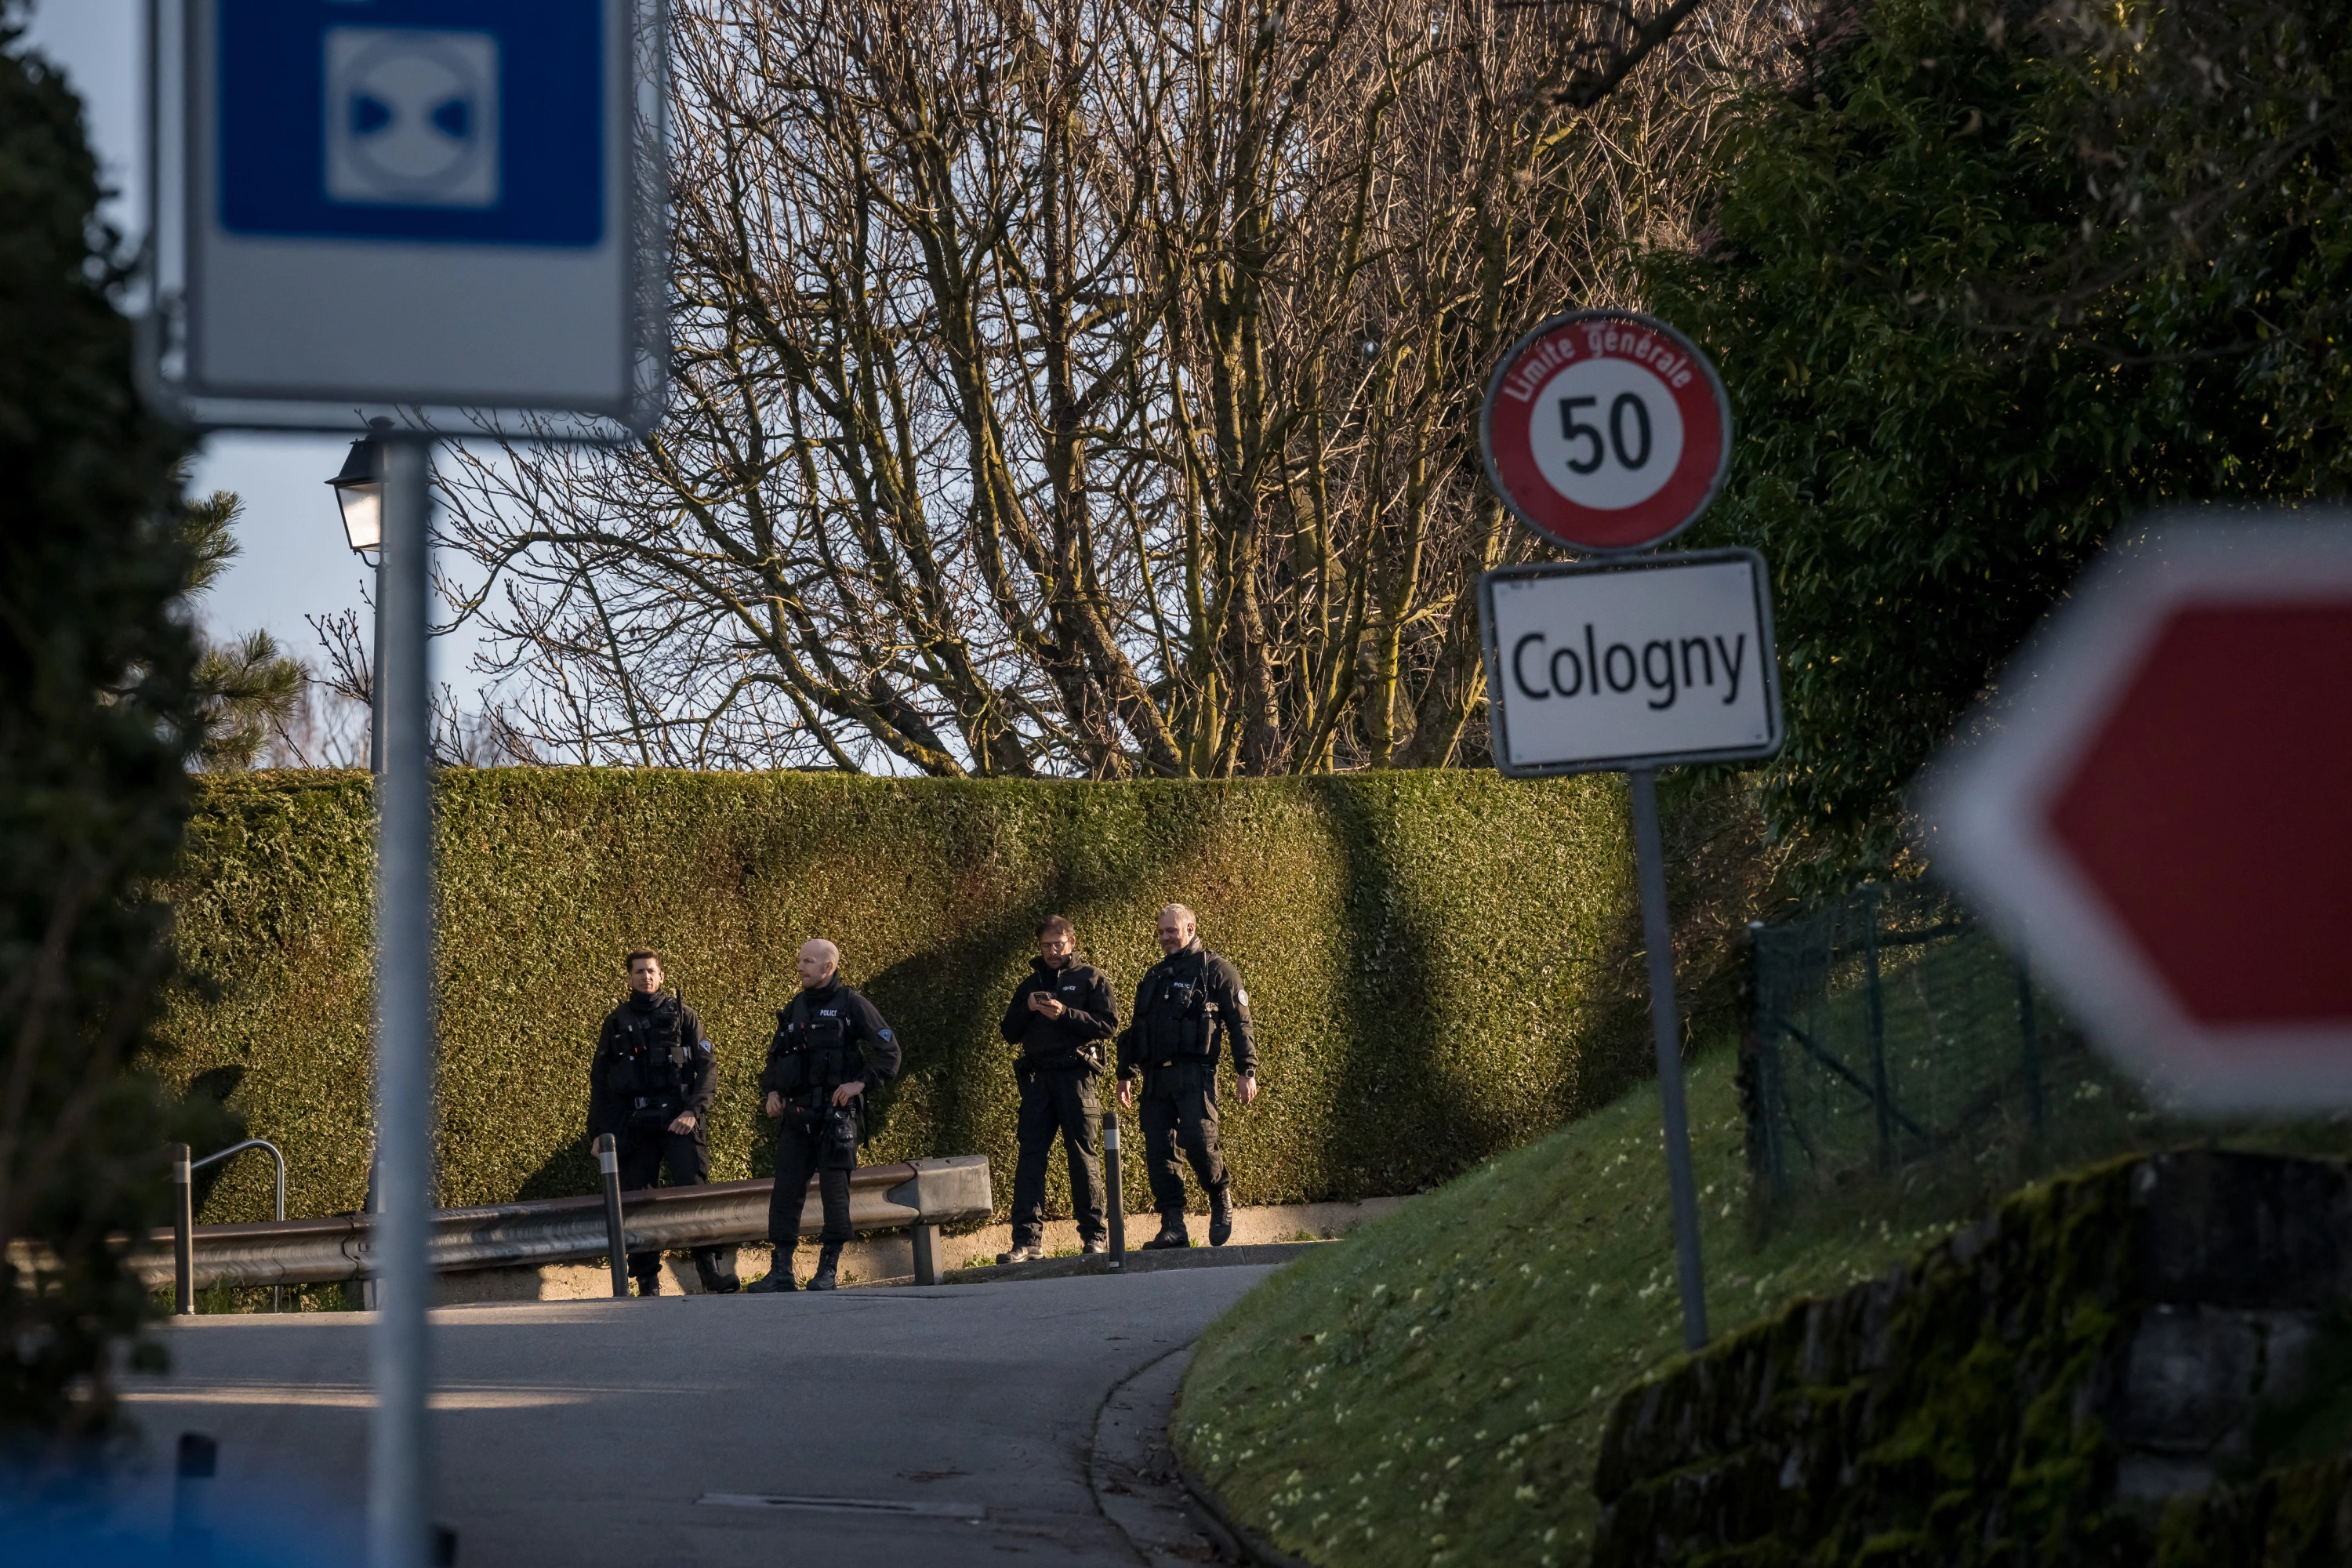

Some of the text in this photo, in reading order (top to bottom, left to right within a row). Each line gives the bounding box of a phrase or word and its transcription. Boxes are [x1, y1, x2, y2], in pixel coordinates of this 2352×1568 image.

[1503, 323, 1692, 403] Limite générale
[1558, 392, 1653, 475] 50
[1512, 624, 1746, 710] Cologny
